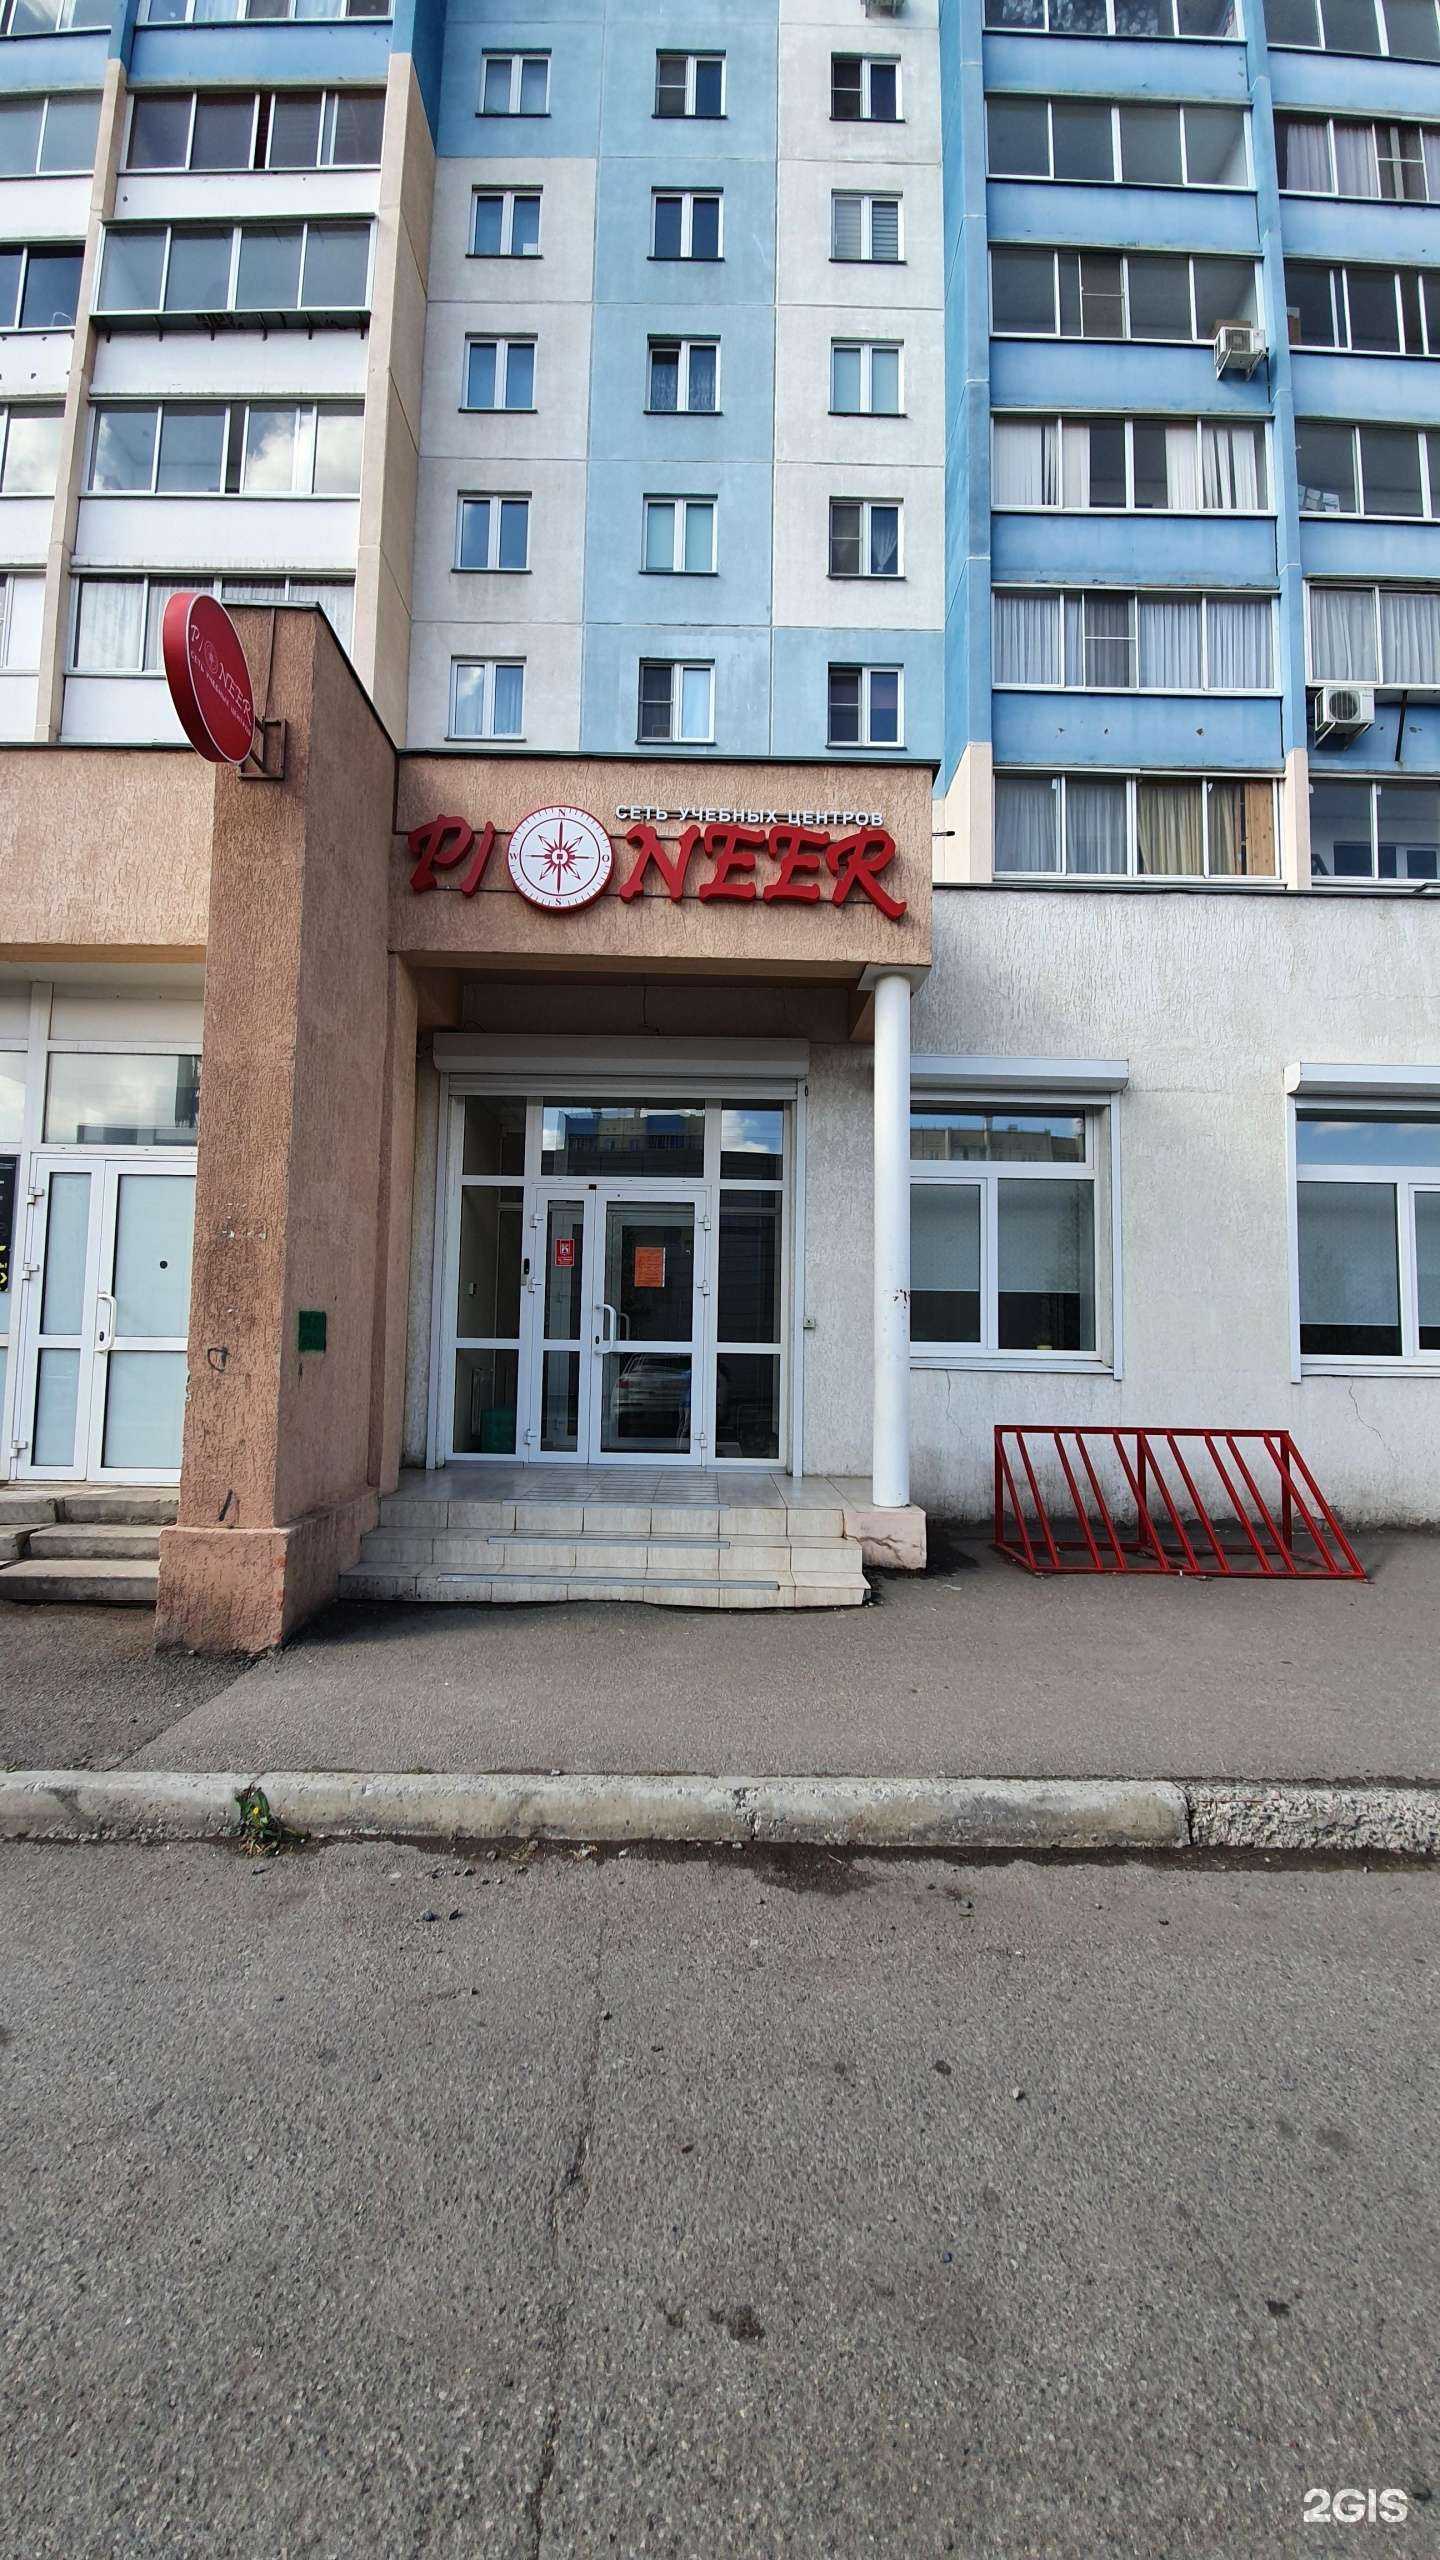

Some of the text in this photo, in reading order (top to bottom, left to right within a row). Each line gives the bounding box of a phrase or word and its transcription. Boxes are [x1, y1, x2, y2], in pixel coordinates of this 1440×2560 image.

[615, 804, 884, 827] СЕТЬ УЧЕБНЫХ ЦЕНТРОВ
